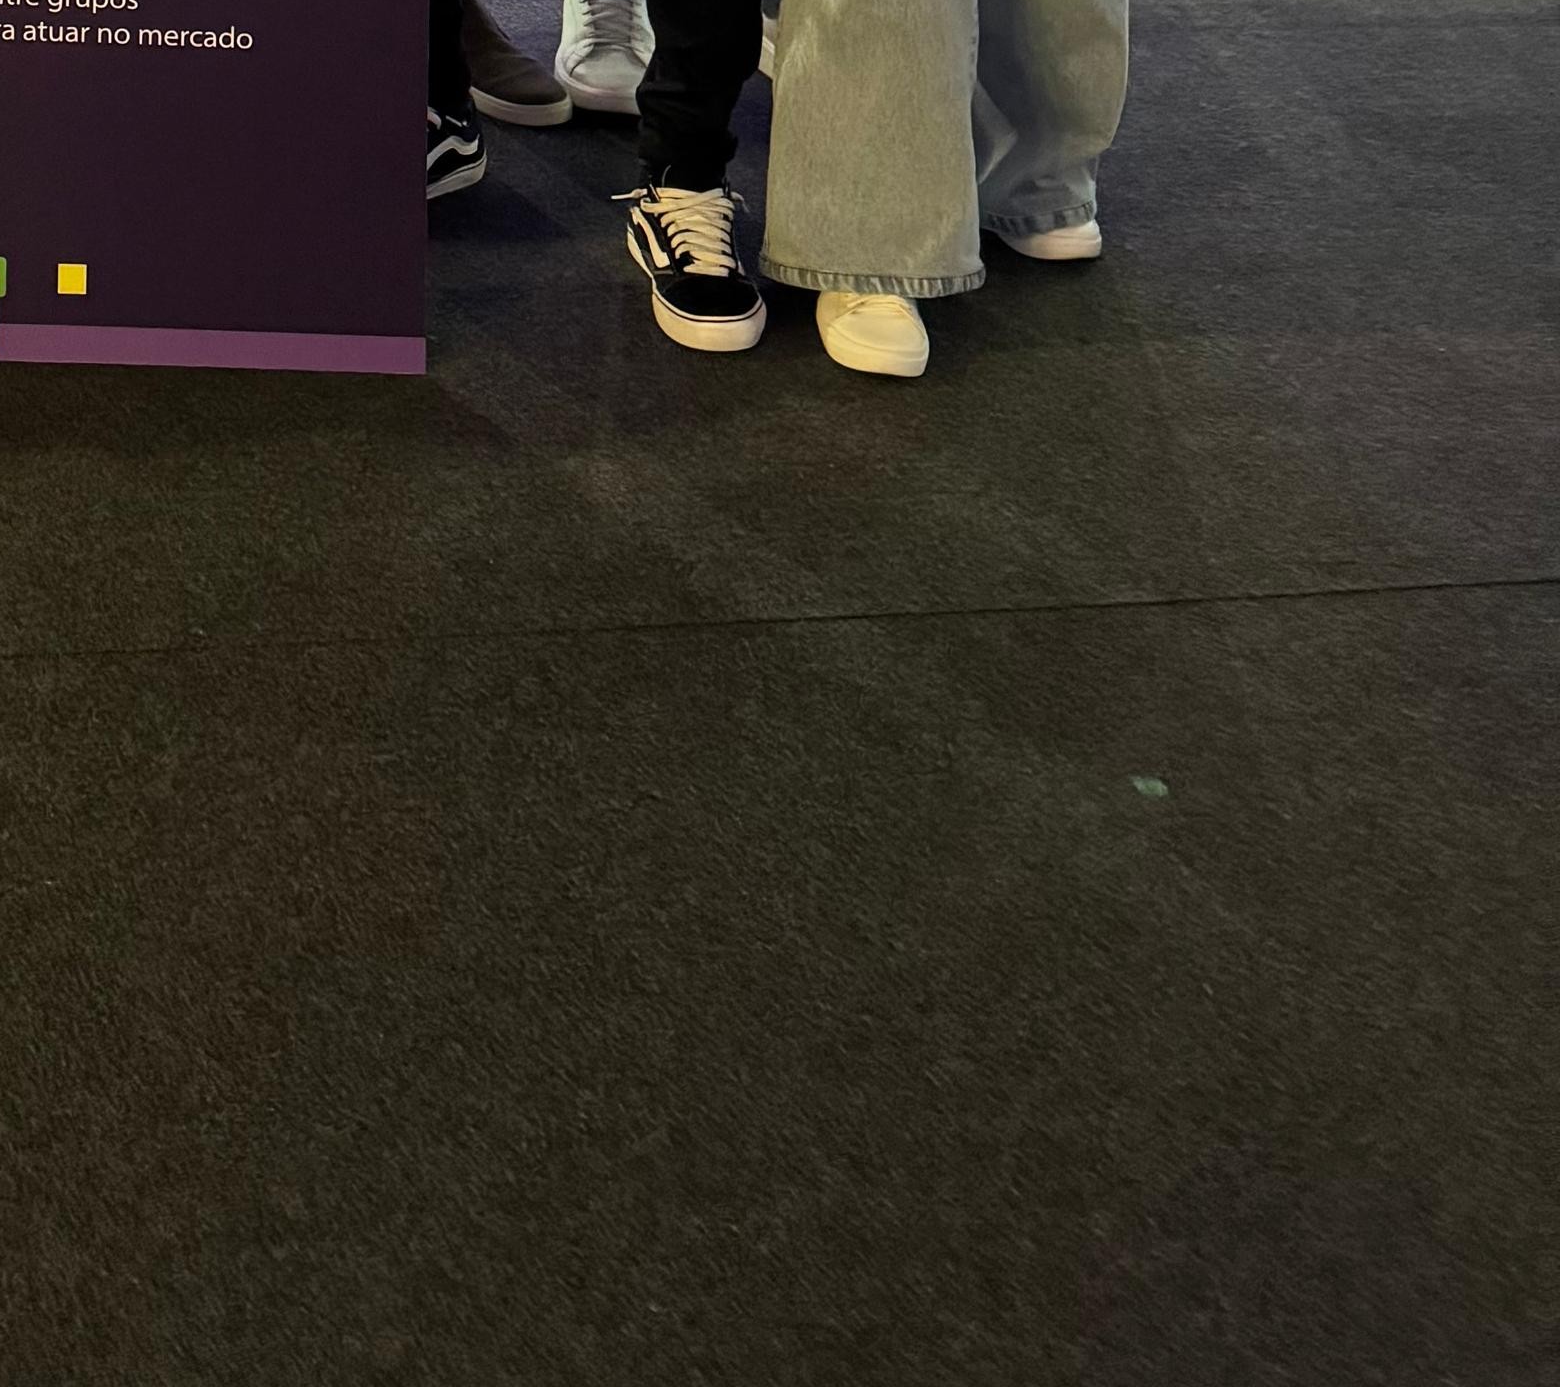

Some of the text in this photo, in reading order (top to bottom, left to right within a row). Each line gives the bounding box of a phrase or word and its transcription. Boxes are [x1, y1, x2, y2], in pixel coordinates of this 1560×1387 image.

[23, 21, 91, 43] atuar
[97, 27, 131, 45] no
[138, 25, 253, 49] mercado
